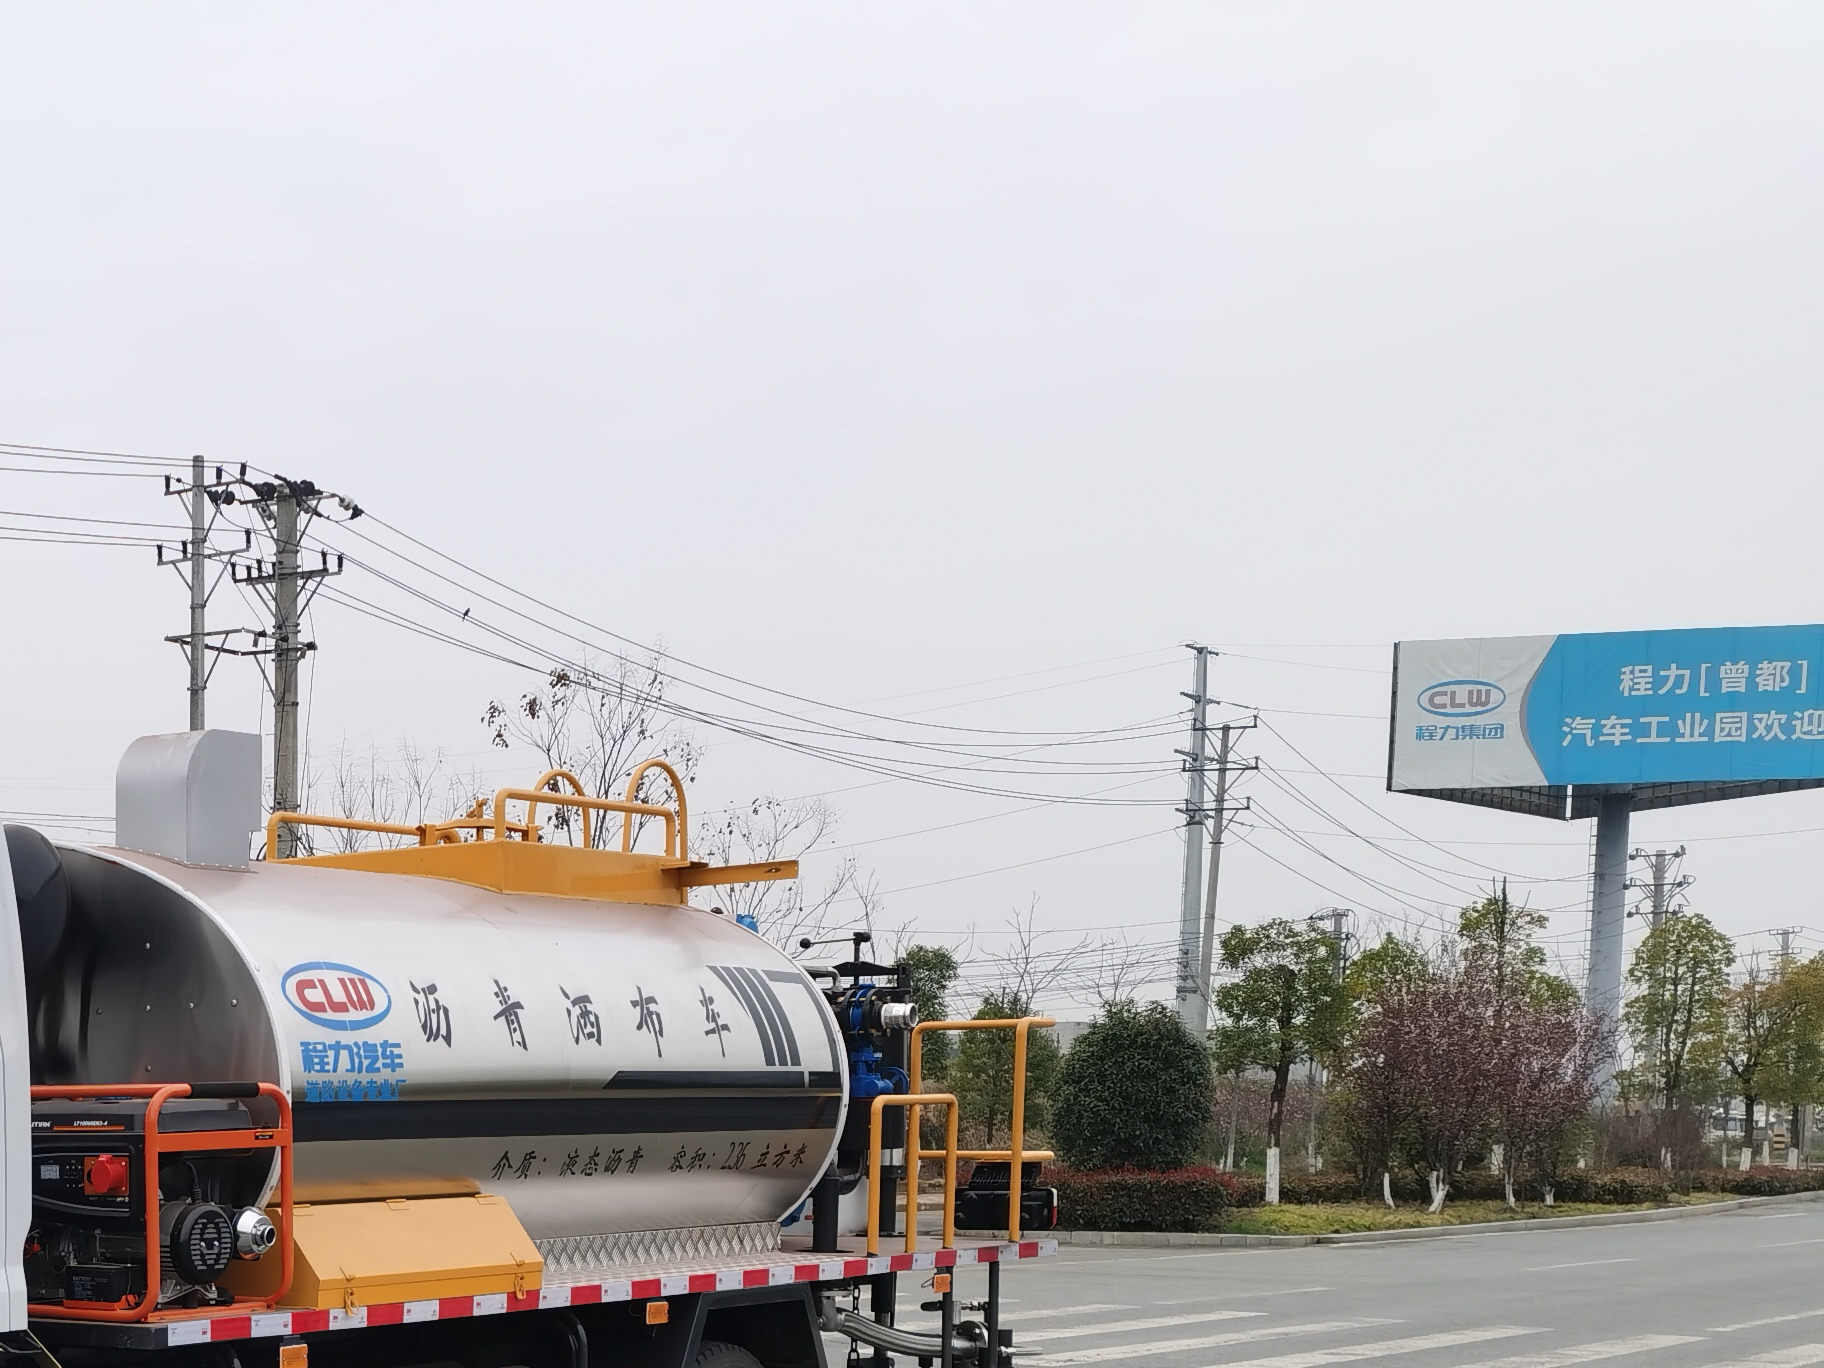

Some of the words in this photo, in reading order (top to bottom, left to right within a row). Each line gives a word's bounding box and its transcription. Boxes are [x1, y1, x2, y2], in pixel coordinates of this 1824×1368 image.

[1619, 660, 1808, 697] 程力[曾都]
[1427, 688, 1492, 710] CLW
[1415, 722, 1505, 741] 程力集团
[1561, 709, 1824, 747] 汽车工业园欢迎
[295, 977, 376, 1013] CLW
[409, 979, 731, 1058] 沥青洒布车
[299, 1040, 404, 1074] 程力汽车
